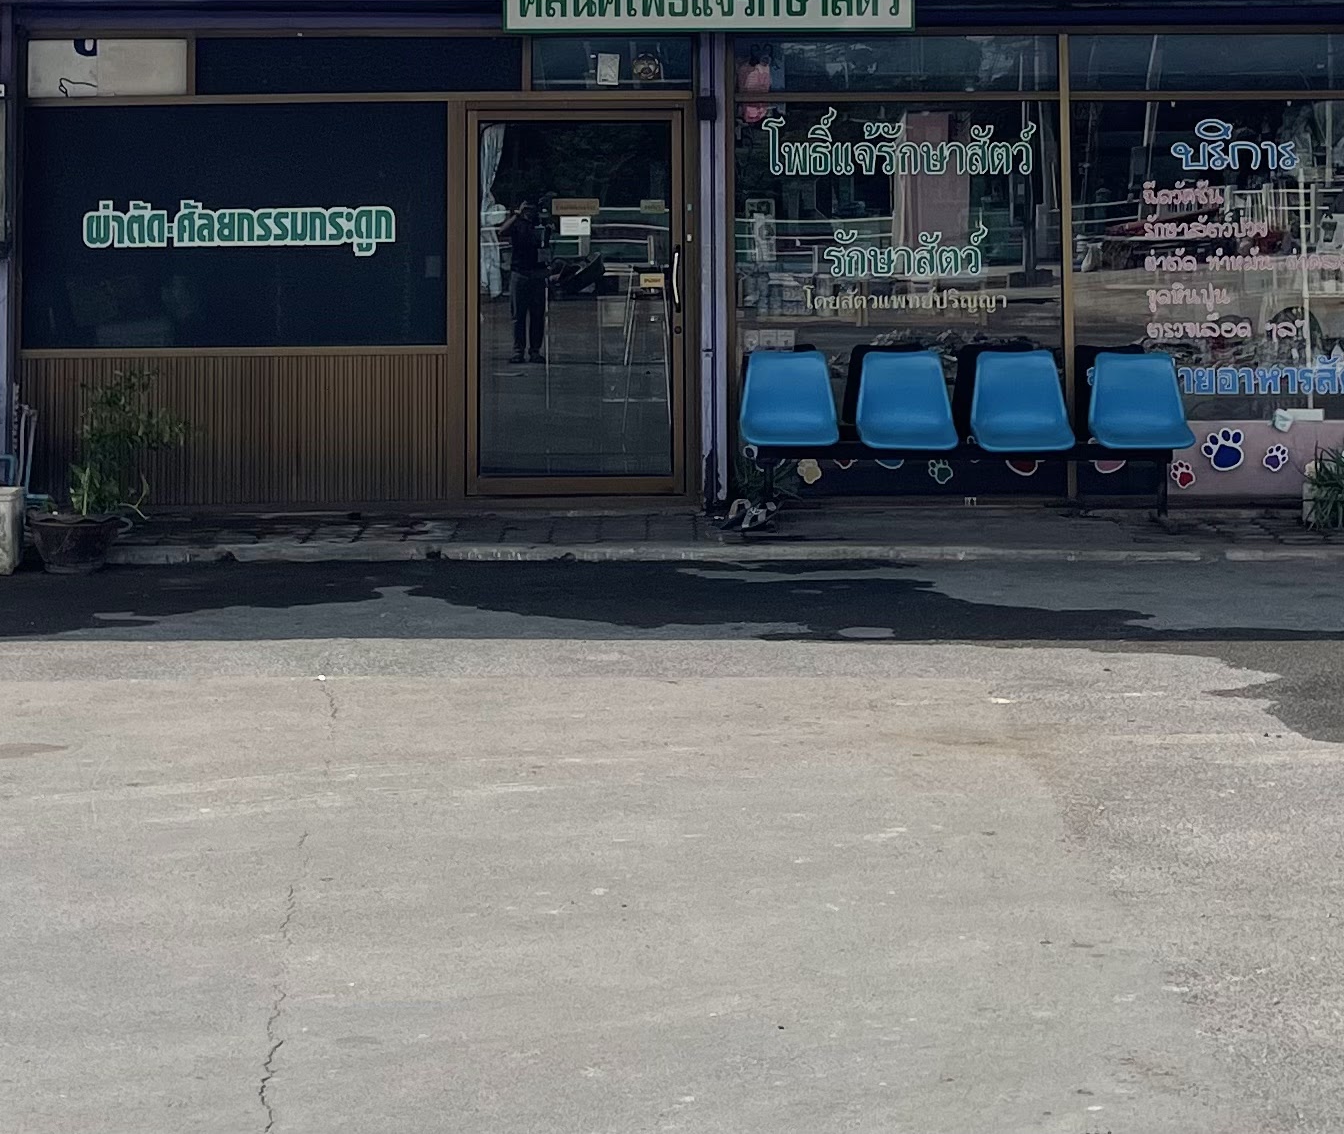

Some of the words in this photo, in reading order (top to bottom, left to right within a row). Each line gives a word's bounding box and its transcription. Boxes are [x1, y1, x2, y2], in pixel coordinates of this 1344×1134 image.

[762, 107, 1037, 175] โพธิ์แจ้รักษาสัตว์
[1170, 119, 1300, 170] บริการ
[824, 224, 988, 276] รักษาสัตว์
[1144, 210, 1268, 239] รักษาสัตว์ป่วย
[803, 285, 1007, 313] โดยสัตวแพทย์ปริญญา
